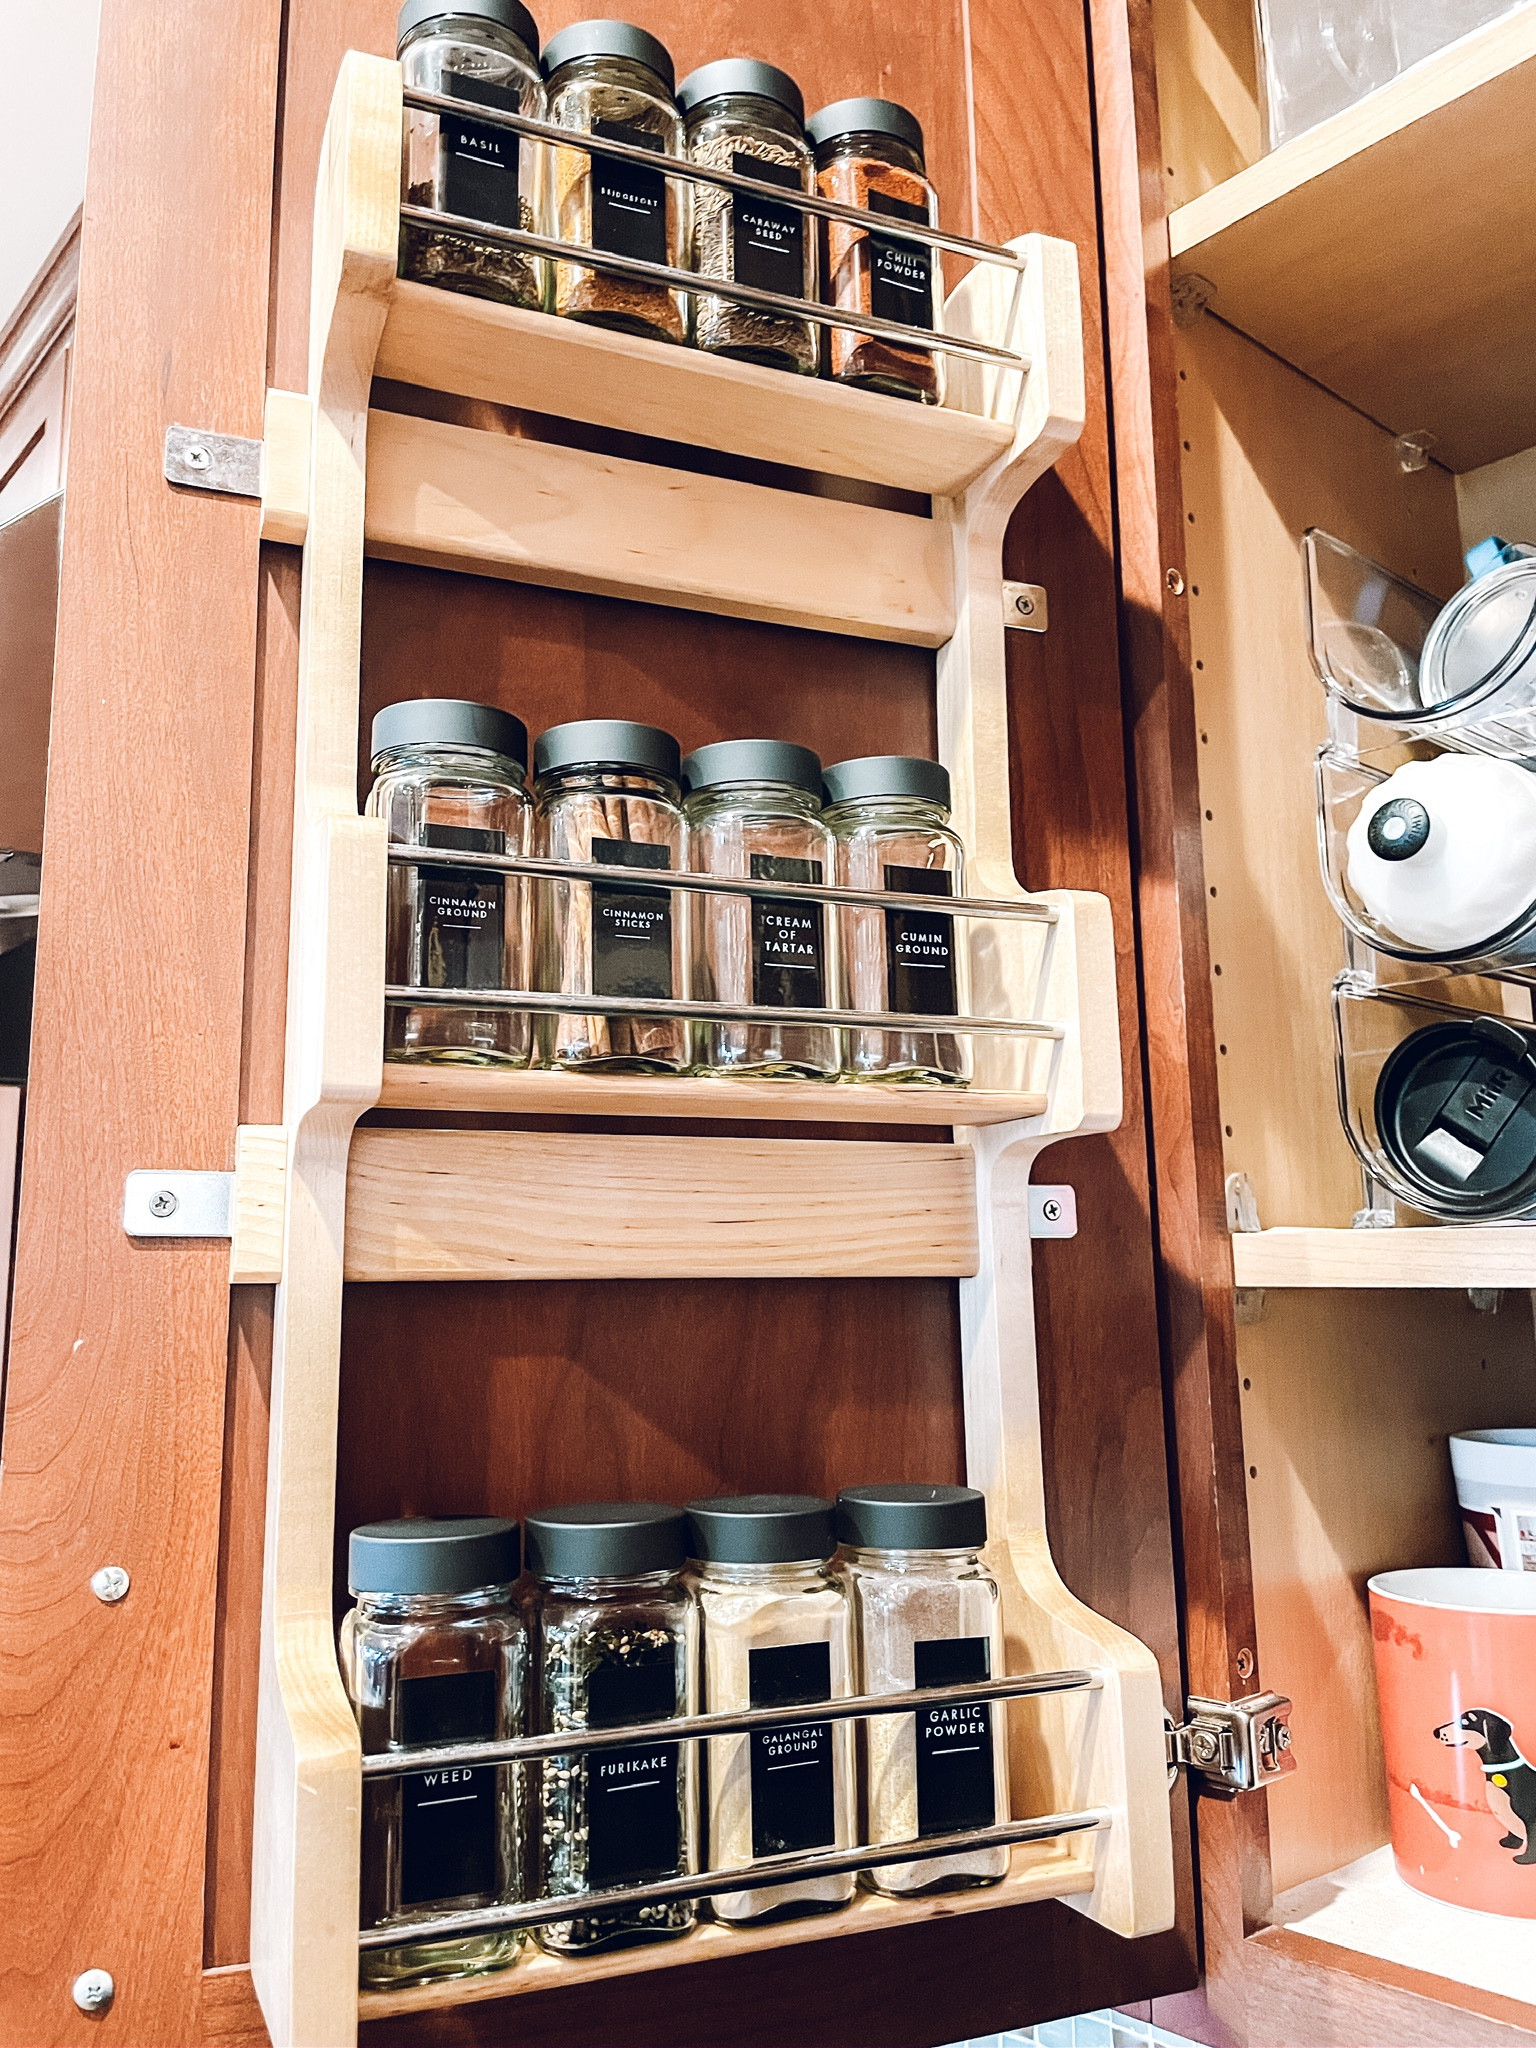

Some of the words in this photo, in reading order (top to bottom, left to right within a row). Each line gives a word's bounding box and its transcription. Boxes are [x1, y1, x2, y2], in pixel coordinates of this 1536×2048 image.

[460, 134, 500, 154] BASIL
[742, 214, 796, 235] CARAWAY
[755, 227, 782, 241] SEED
[885, 250, 918, 268] CHILI
[877, 259, 926, 281] POWDER
[429, 896, 496, 910] CINNAMON
[437, 907, 488, 919] GROUND
[602, 908, 664, 921] CINNAMON
[615, 918, 651, 929] STICKS
[766, 915, 812, 929] CREAM
[778, 929, 797, 940] OF
[900, 932, 943, 944] CUMIN
[764, 941, 814, 955] TARTAR
[895, 943, 949, 956] GROUND
[929, 1706, 982, 1723] GARLIC
[762, 1728, 824, 1745] GALANGAL
[925, 1722, 986, 1739] POWDER
[768, 1740, 818, 1756] GROUND
[600, 1756, 667, 1777] FURIKAKE
[424, 1769, 473, 1787] WEED
